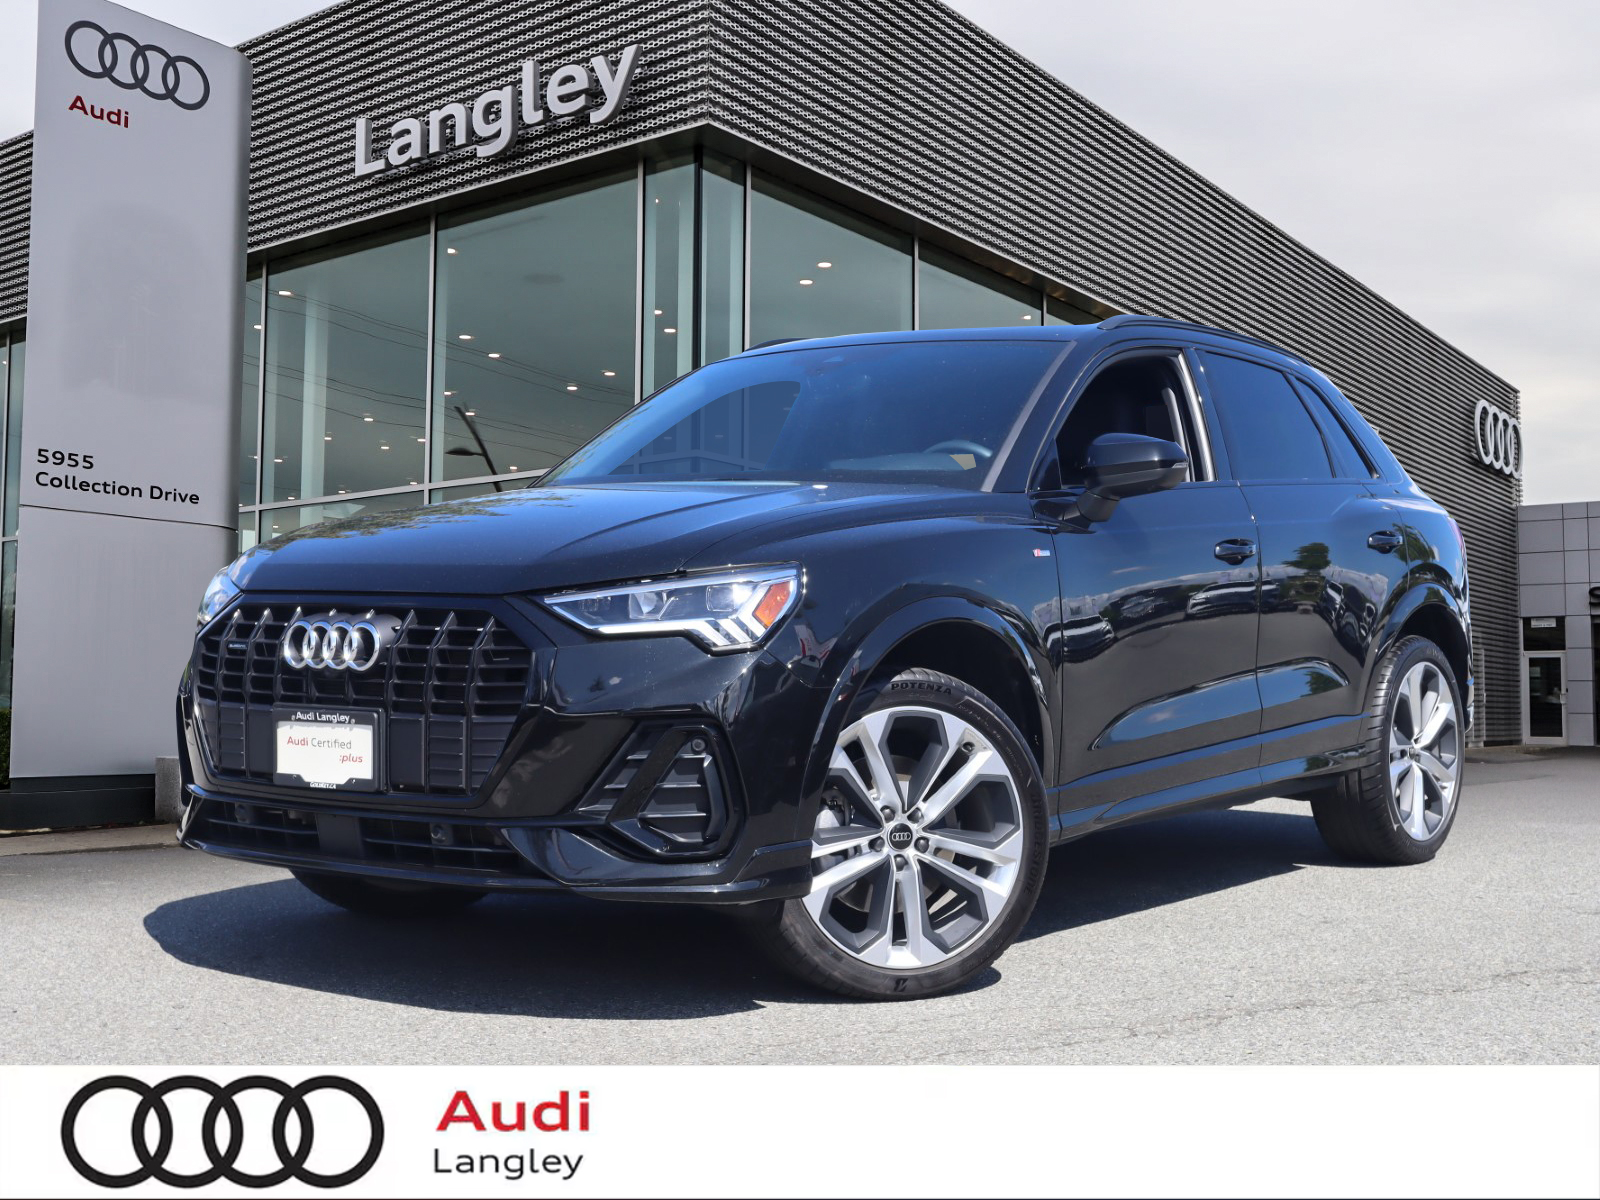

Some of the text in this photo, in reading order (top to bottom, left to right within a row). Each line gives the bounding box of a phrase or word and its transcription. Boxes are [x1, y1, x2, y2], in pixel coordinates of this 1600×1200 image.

[68, 95, 129, 128] Audi
[355, 44, 643, 177] Langley
[37, 448, 94, 470] 5955
[35, 471, 200, 505] Collection Drive
[891, 681, 952, 695] POTENZA
[296, 711, 350, 724] Audi Langley
[287, 735, 352, 750] Audi Certified
